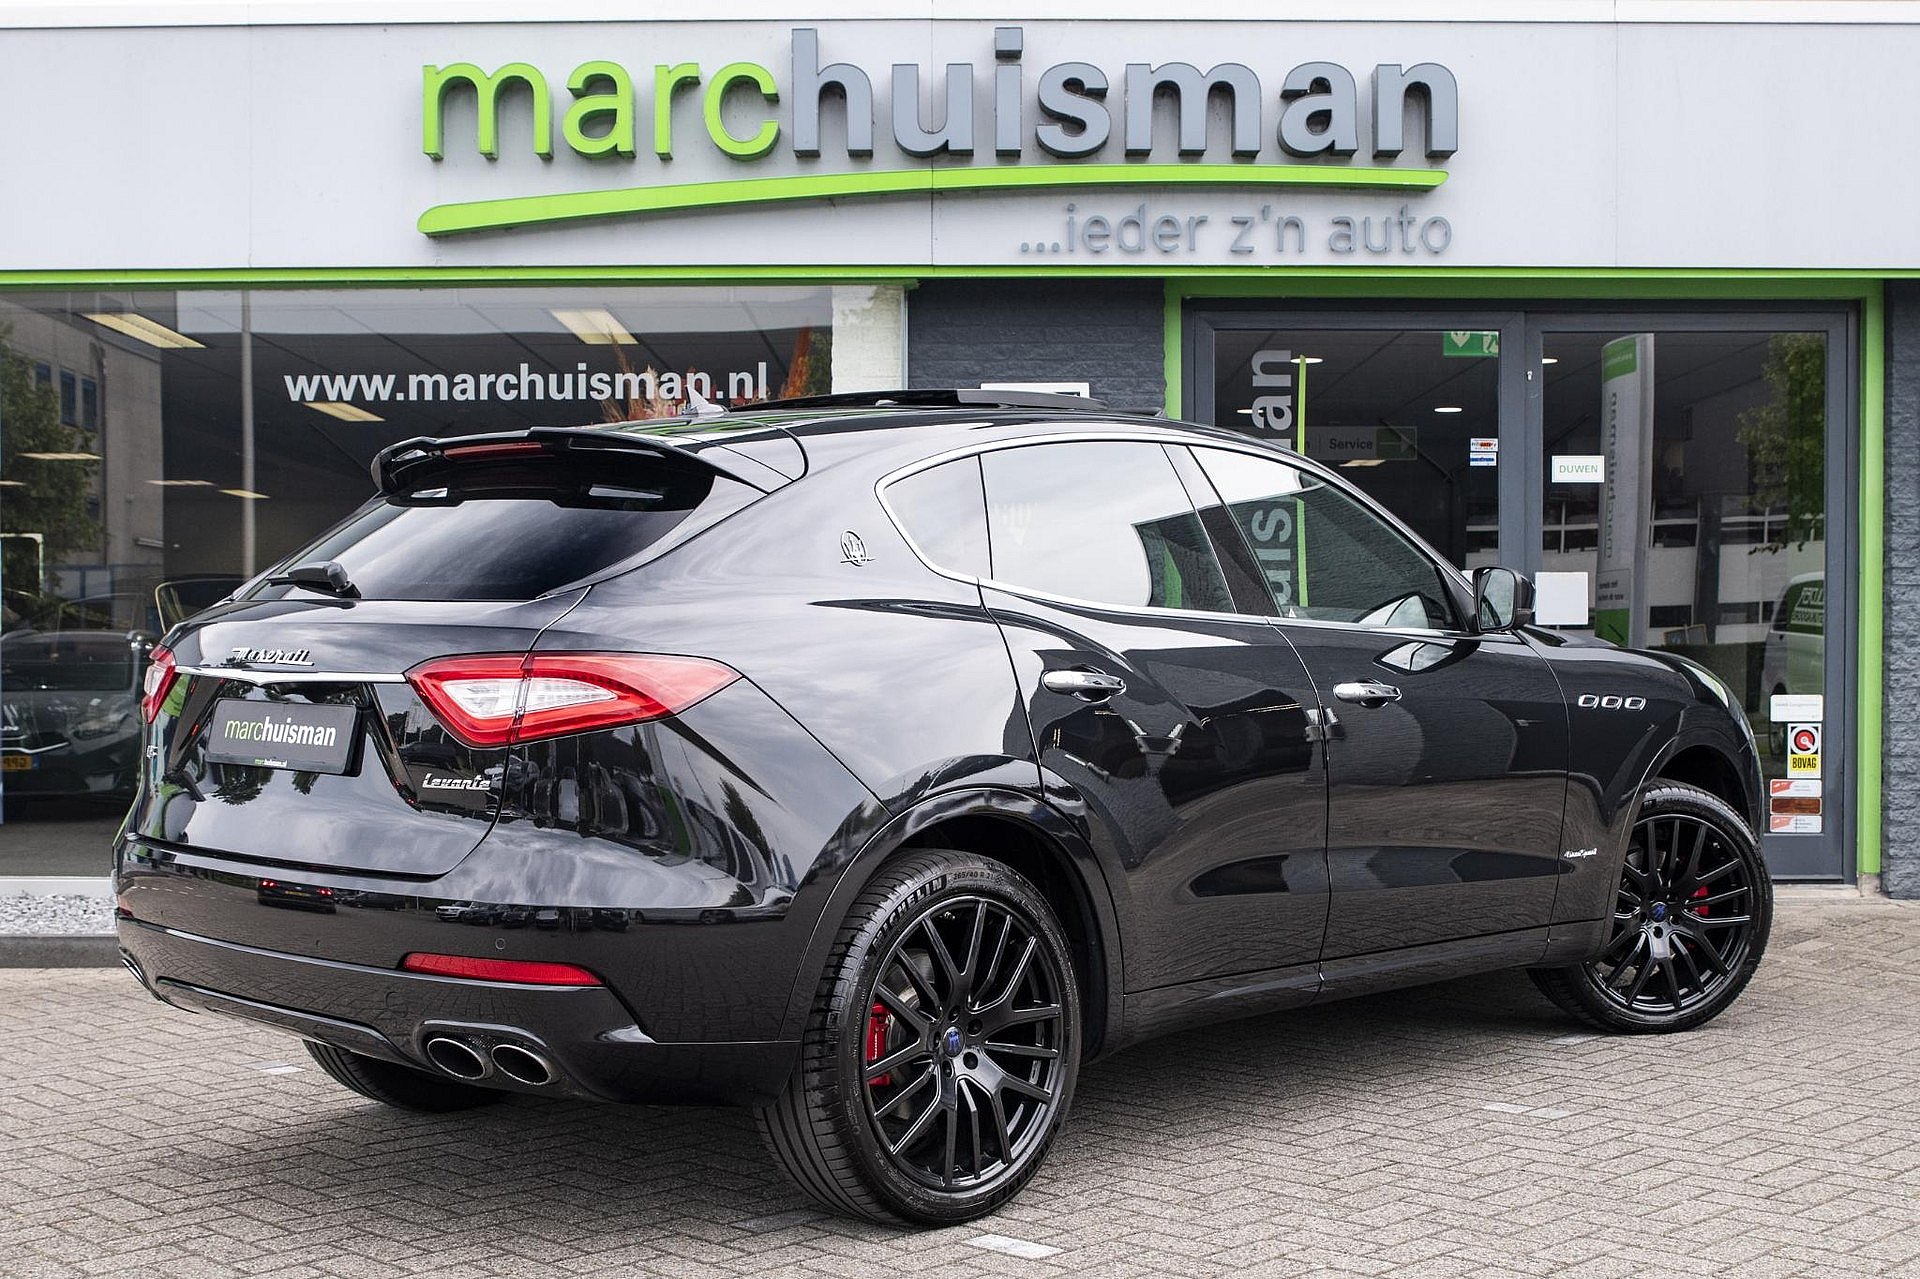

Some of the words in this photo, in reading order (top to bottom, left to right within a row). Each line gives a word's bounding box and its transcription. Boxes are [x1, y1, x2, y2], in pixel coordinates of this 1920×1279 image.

[422, 27, 1459, 161] marchuisman
[1020, 203, 1208, 253] ...ieder
[1230, 204, 1305, 253] z'n
[1328, 204, 1452, 253] auto
[284, 361, 768, 402] www.marchuisman.nl
[1329, 438, 1373, 450] Service
[1559, 464, 1598, 474] DUWEN
[224, 716, 336, 747] marchuisman
[1792, 757, 1817, 769] BOVAG
[422, 772, 491, 791] Levante
[872, 876, 943, 949] MICHELIN
